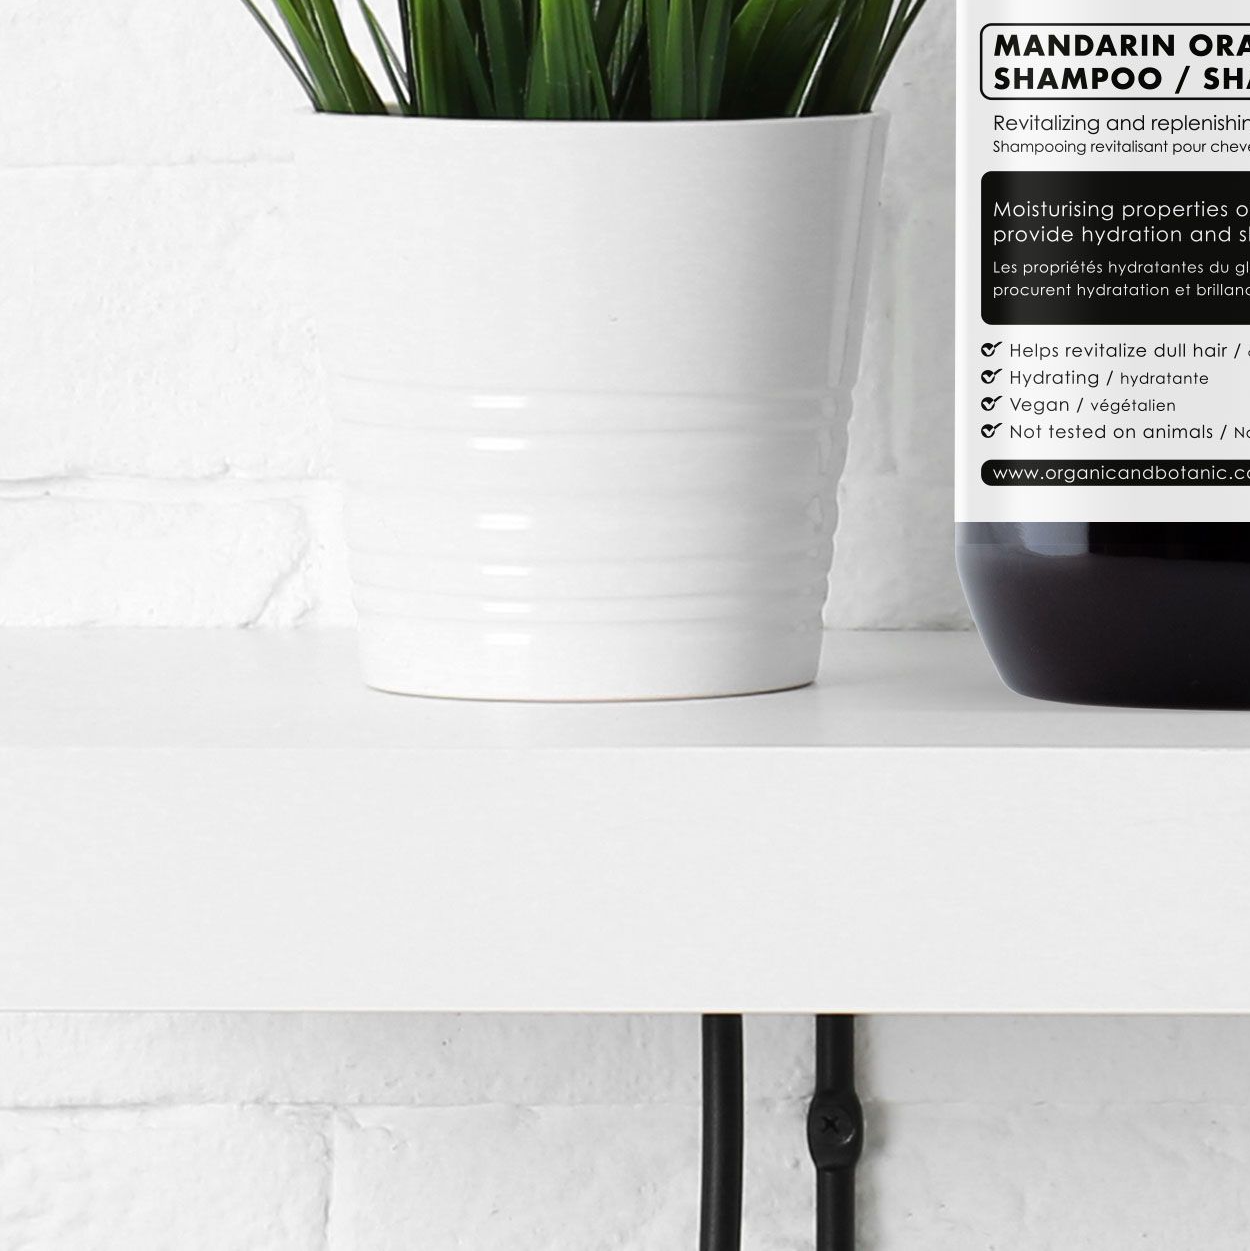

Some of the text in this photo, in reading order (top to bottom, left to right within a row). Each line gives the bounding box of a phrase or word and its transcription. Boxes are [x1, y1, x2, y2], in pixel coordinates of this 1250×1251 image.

[993, 33, 1175, 57] MANDARIN
[993, 66, 1163, 91] SHAMPOO
[1174, 65, 1191, 95] /
[993, 114, 1100, 135] Revitalizing
[1106, 114, 1145, 132] and
[992, 139, 1087, 156] Shampooing
[1090, 139, 1169, 153] revitalisant
[1172, 142, 1207, 156] pour
[993, 200, 1114, 222] Moisturising
[1122, 200, 1228, 221] properties
[993, 225, 1074, 246] provide
[1082, 225, 1182, 246] hydration
[1190, 225, 1231, 243] and
[993, 261, 1018, 274] Les
[1023, 259, 1103, 277] propriétés
[1108, 260, 1204, 277] hydratantes
[1209, 260, 1230, 274] du
[993, 283, 1072, 299] procurent
[1077, 283, 1169, 299] hydratation
[1174, 283, 1191, 297] et
[1010, 342, 1059, 361] Helps
[1065, 342, 1147, 358] revitalize
[1153, 342, 1186, 358] dull
[1193, 342, 1228, 358] hair
[1233, 342, 1242, 360] /
[1010, 369, 1209, 389] Hydrating / hydratante
[1009, 397, 1176, 416] Vegan / végétalien
[1010, 424, 1042, 439] Not
[1048, 424, 1106, 439] tested
[1112, 427, 1136, 439] on
[1142, 424, 1213, 439] animals
[1219, 424, 1228, 441] /
